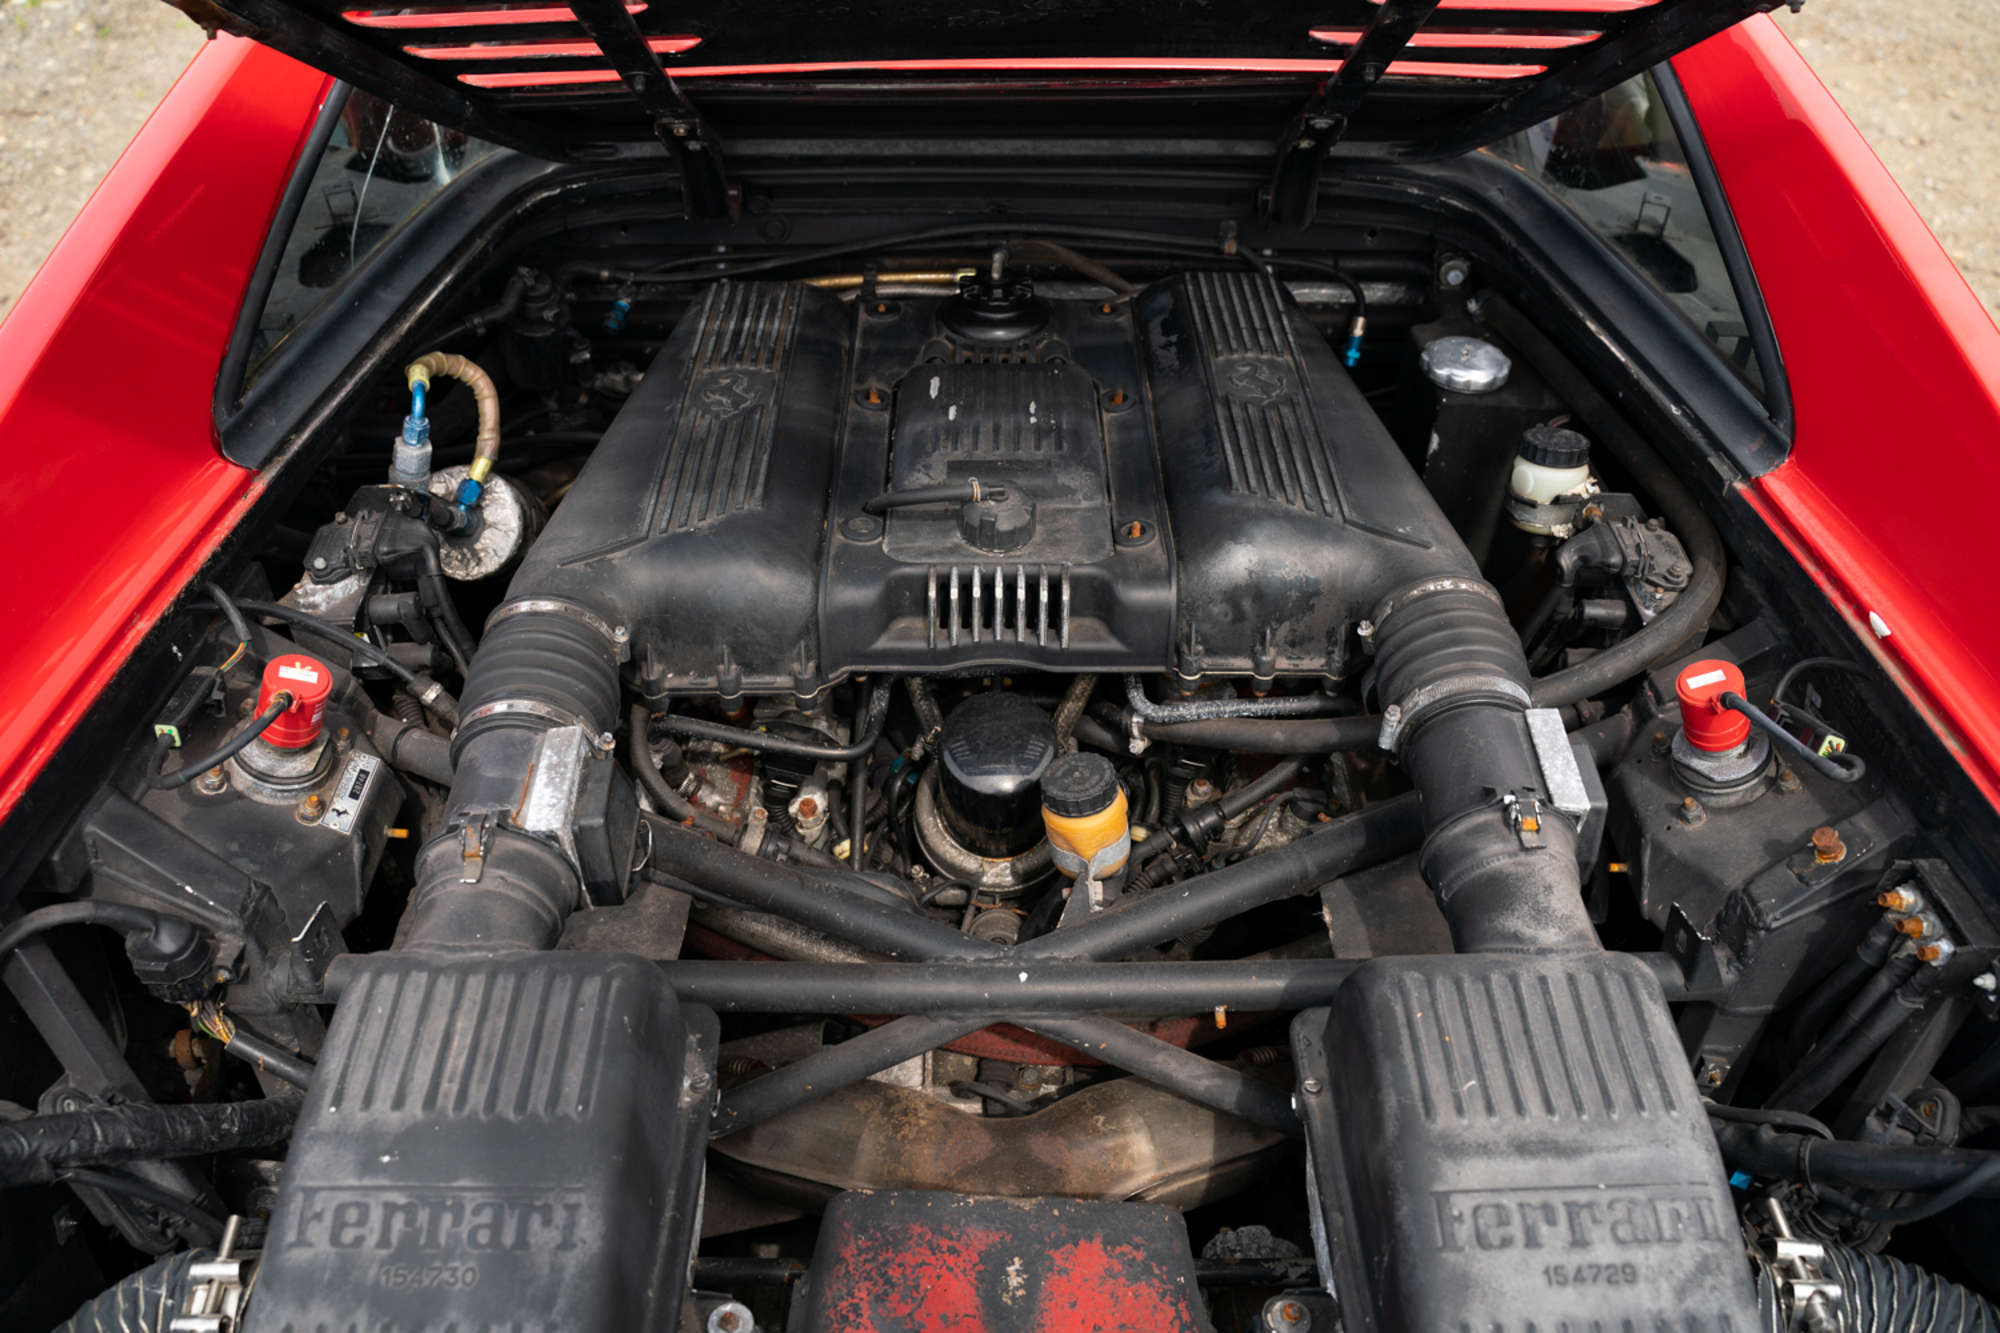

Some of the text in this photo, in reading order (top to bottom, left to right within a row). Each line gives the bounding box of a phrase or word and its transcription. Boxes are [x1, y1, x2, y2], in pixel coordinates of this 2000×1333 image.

[285, 1185, 585, 1250] Ferrari
[1431, 1183, 1727, 1251] Ferrari
[380, 1262, 477, 1288] 154730
[1542, 1262, 1637, 1287] 154729
